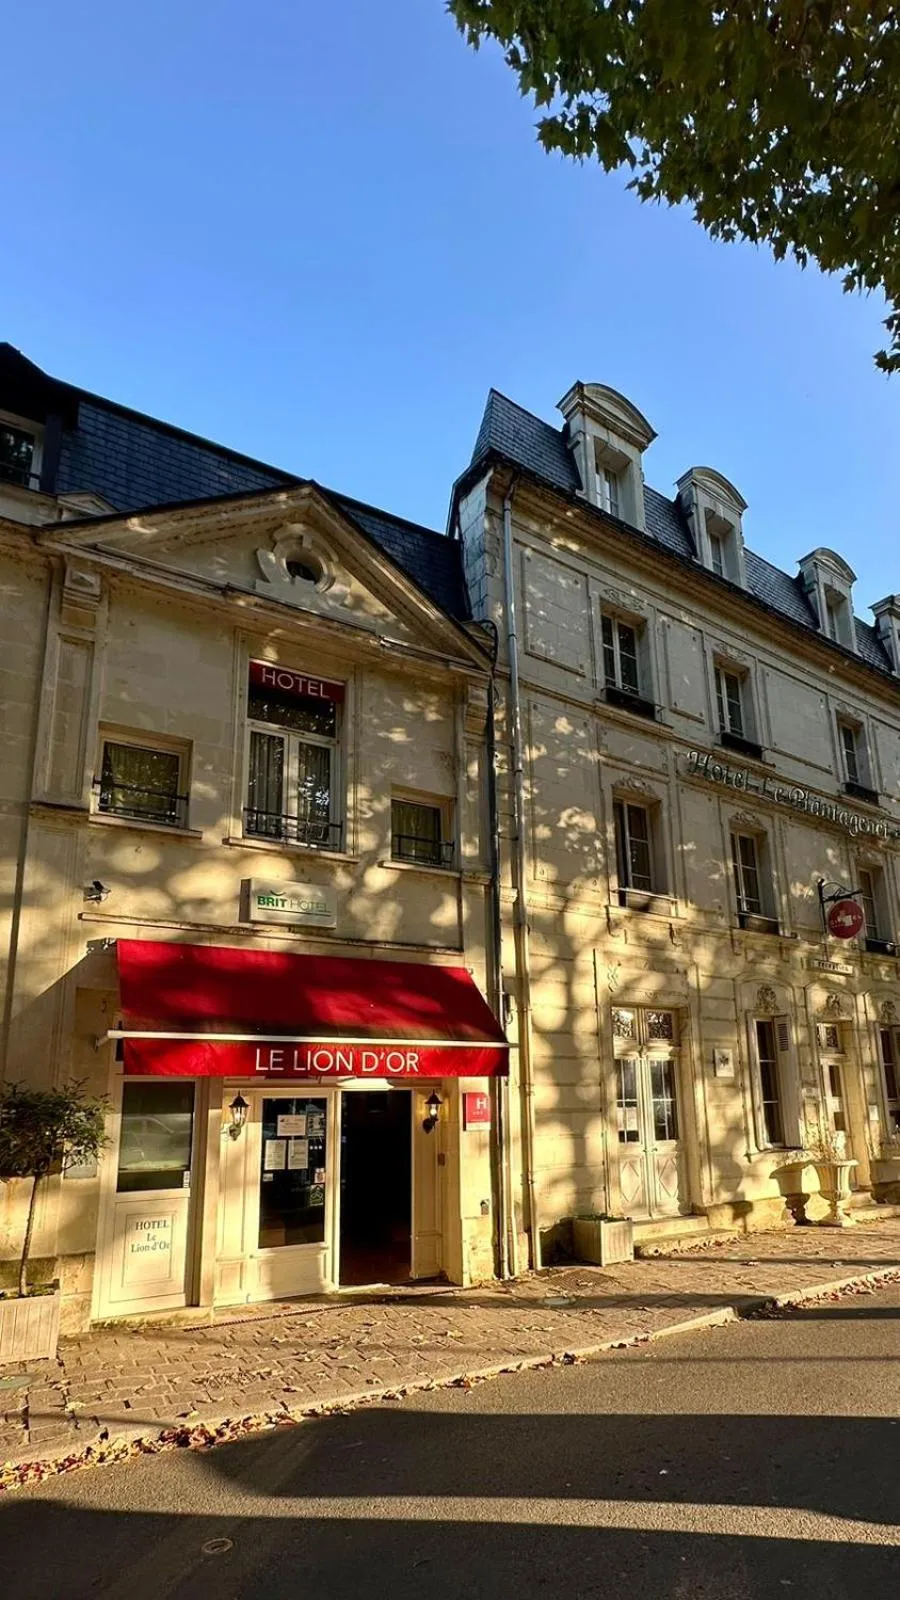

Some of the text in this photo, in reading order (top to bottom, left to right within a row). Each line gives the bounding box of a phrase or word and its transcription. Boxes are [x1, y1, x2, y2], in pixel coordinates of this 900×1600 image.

[261, 667, 330, 699] HOTEL
[257, 895, 331, 913] BRIT HOTEL
[255, 1048, 419, 1074] LE LION D'OR
[476, 1097, 487, 1110] H
[135, 1219, 170, 1231] HOTEL
[147, 1232, 157, 1242] Le
[131, 1240, 170, 1253] Lion d'Or
